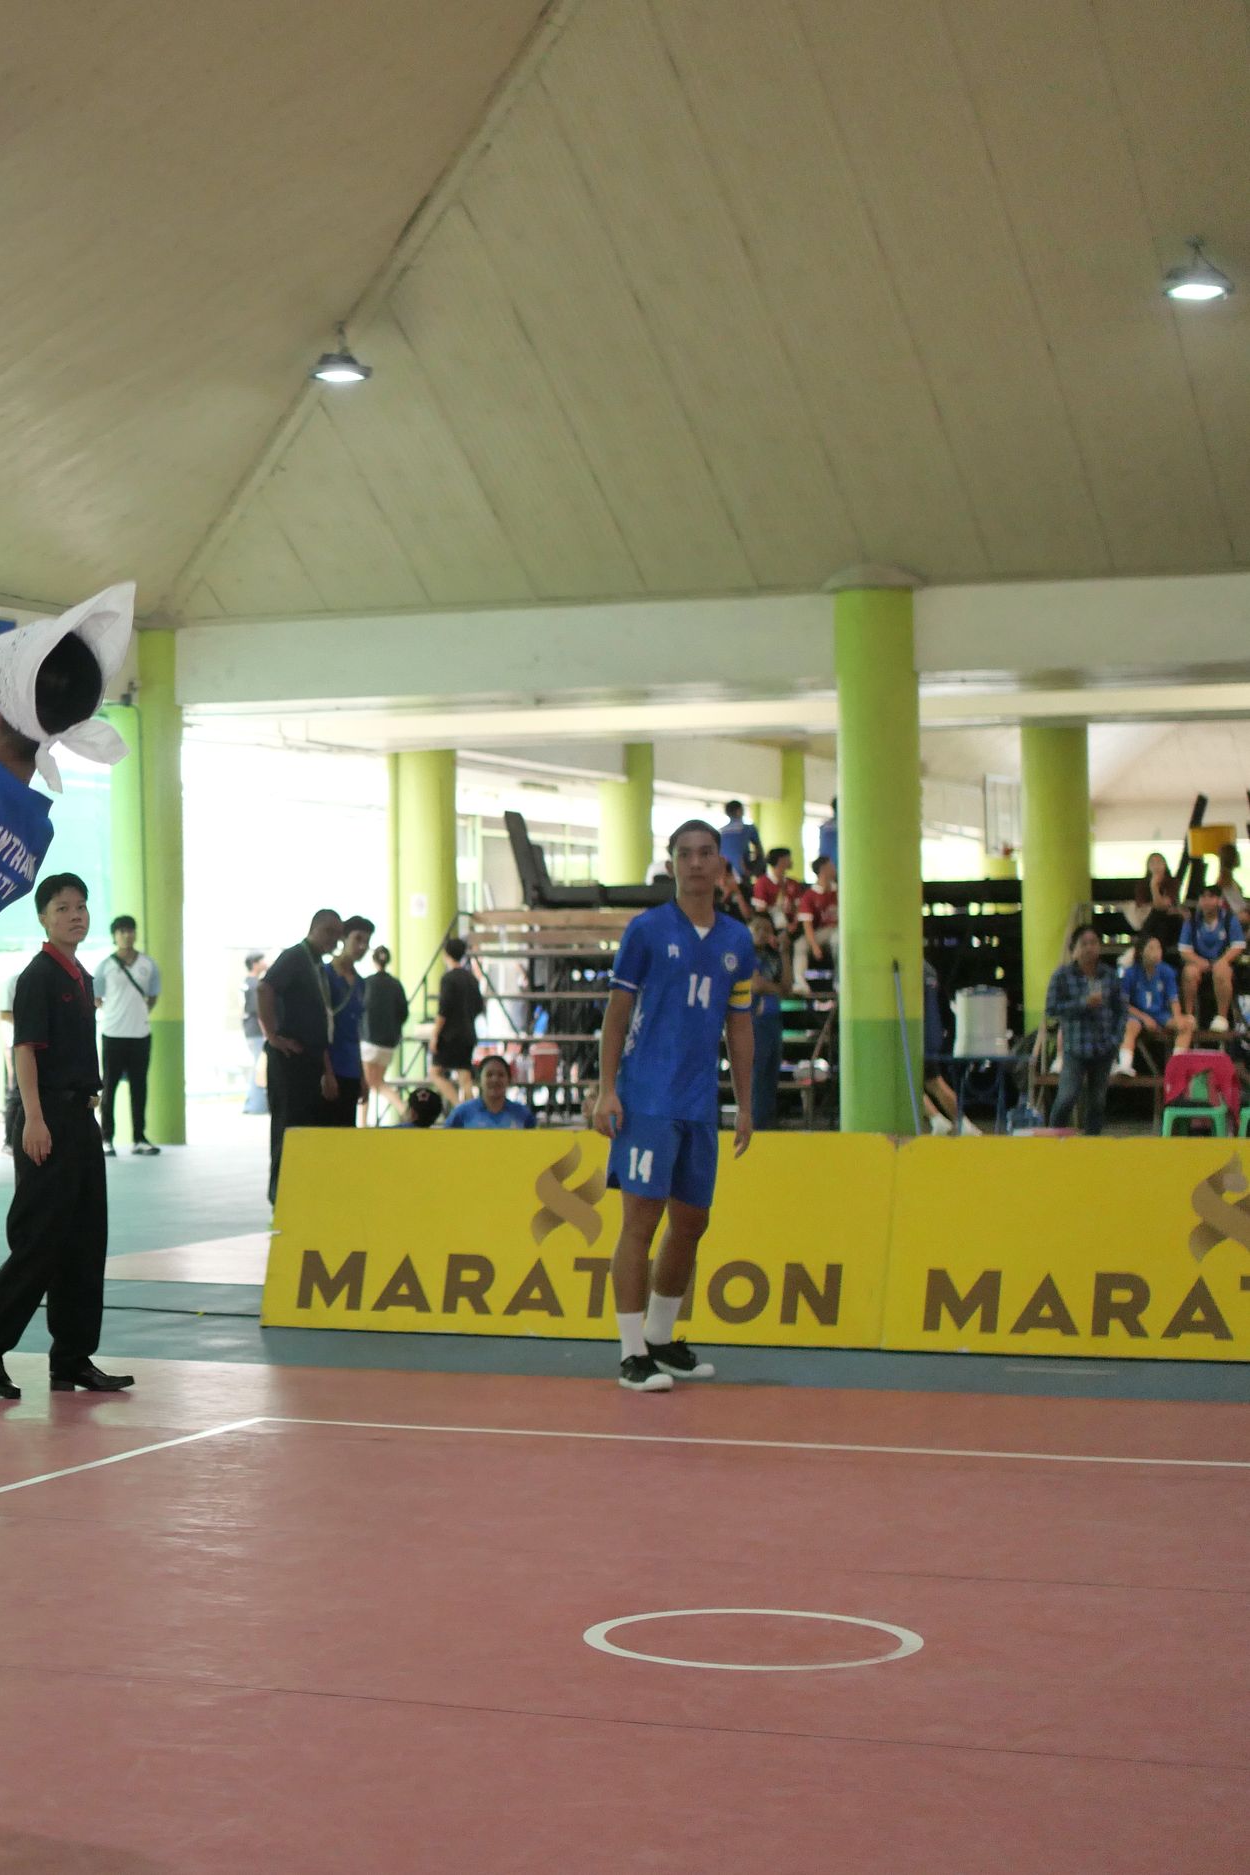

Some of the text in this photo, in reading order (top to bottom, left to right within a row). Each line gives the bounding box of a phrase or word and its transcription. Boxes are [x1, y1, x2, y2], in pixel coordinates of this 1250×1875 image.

[687, 973, 712, 1009] 14
[628, 1147, 654, 1184] 14
[296, 1249, 845, 1327] MARATON
[922, 1267, 1250, 1341] MARA
